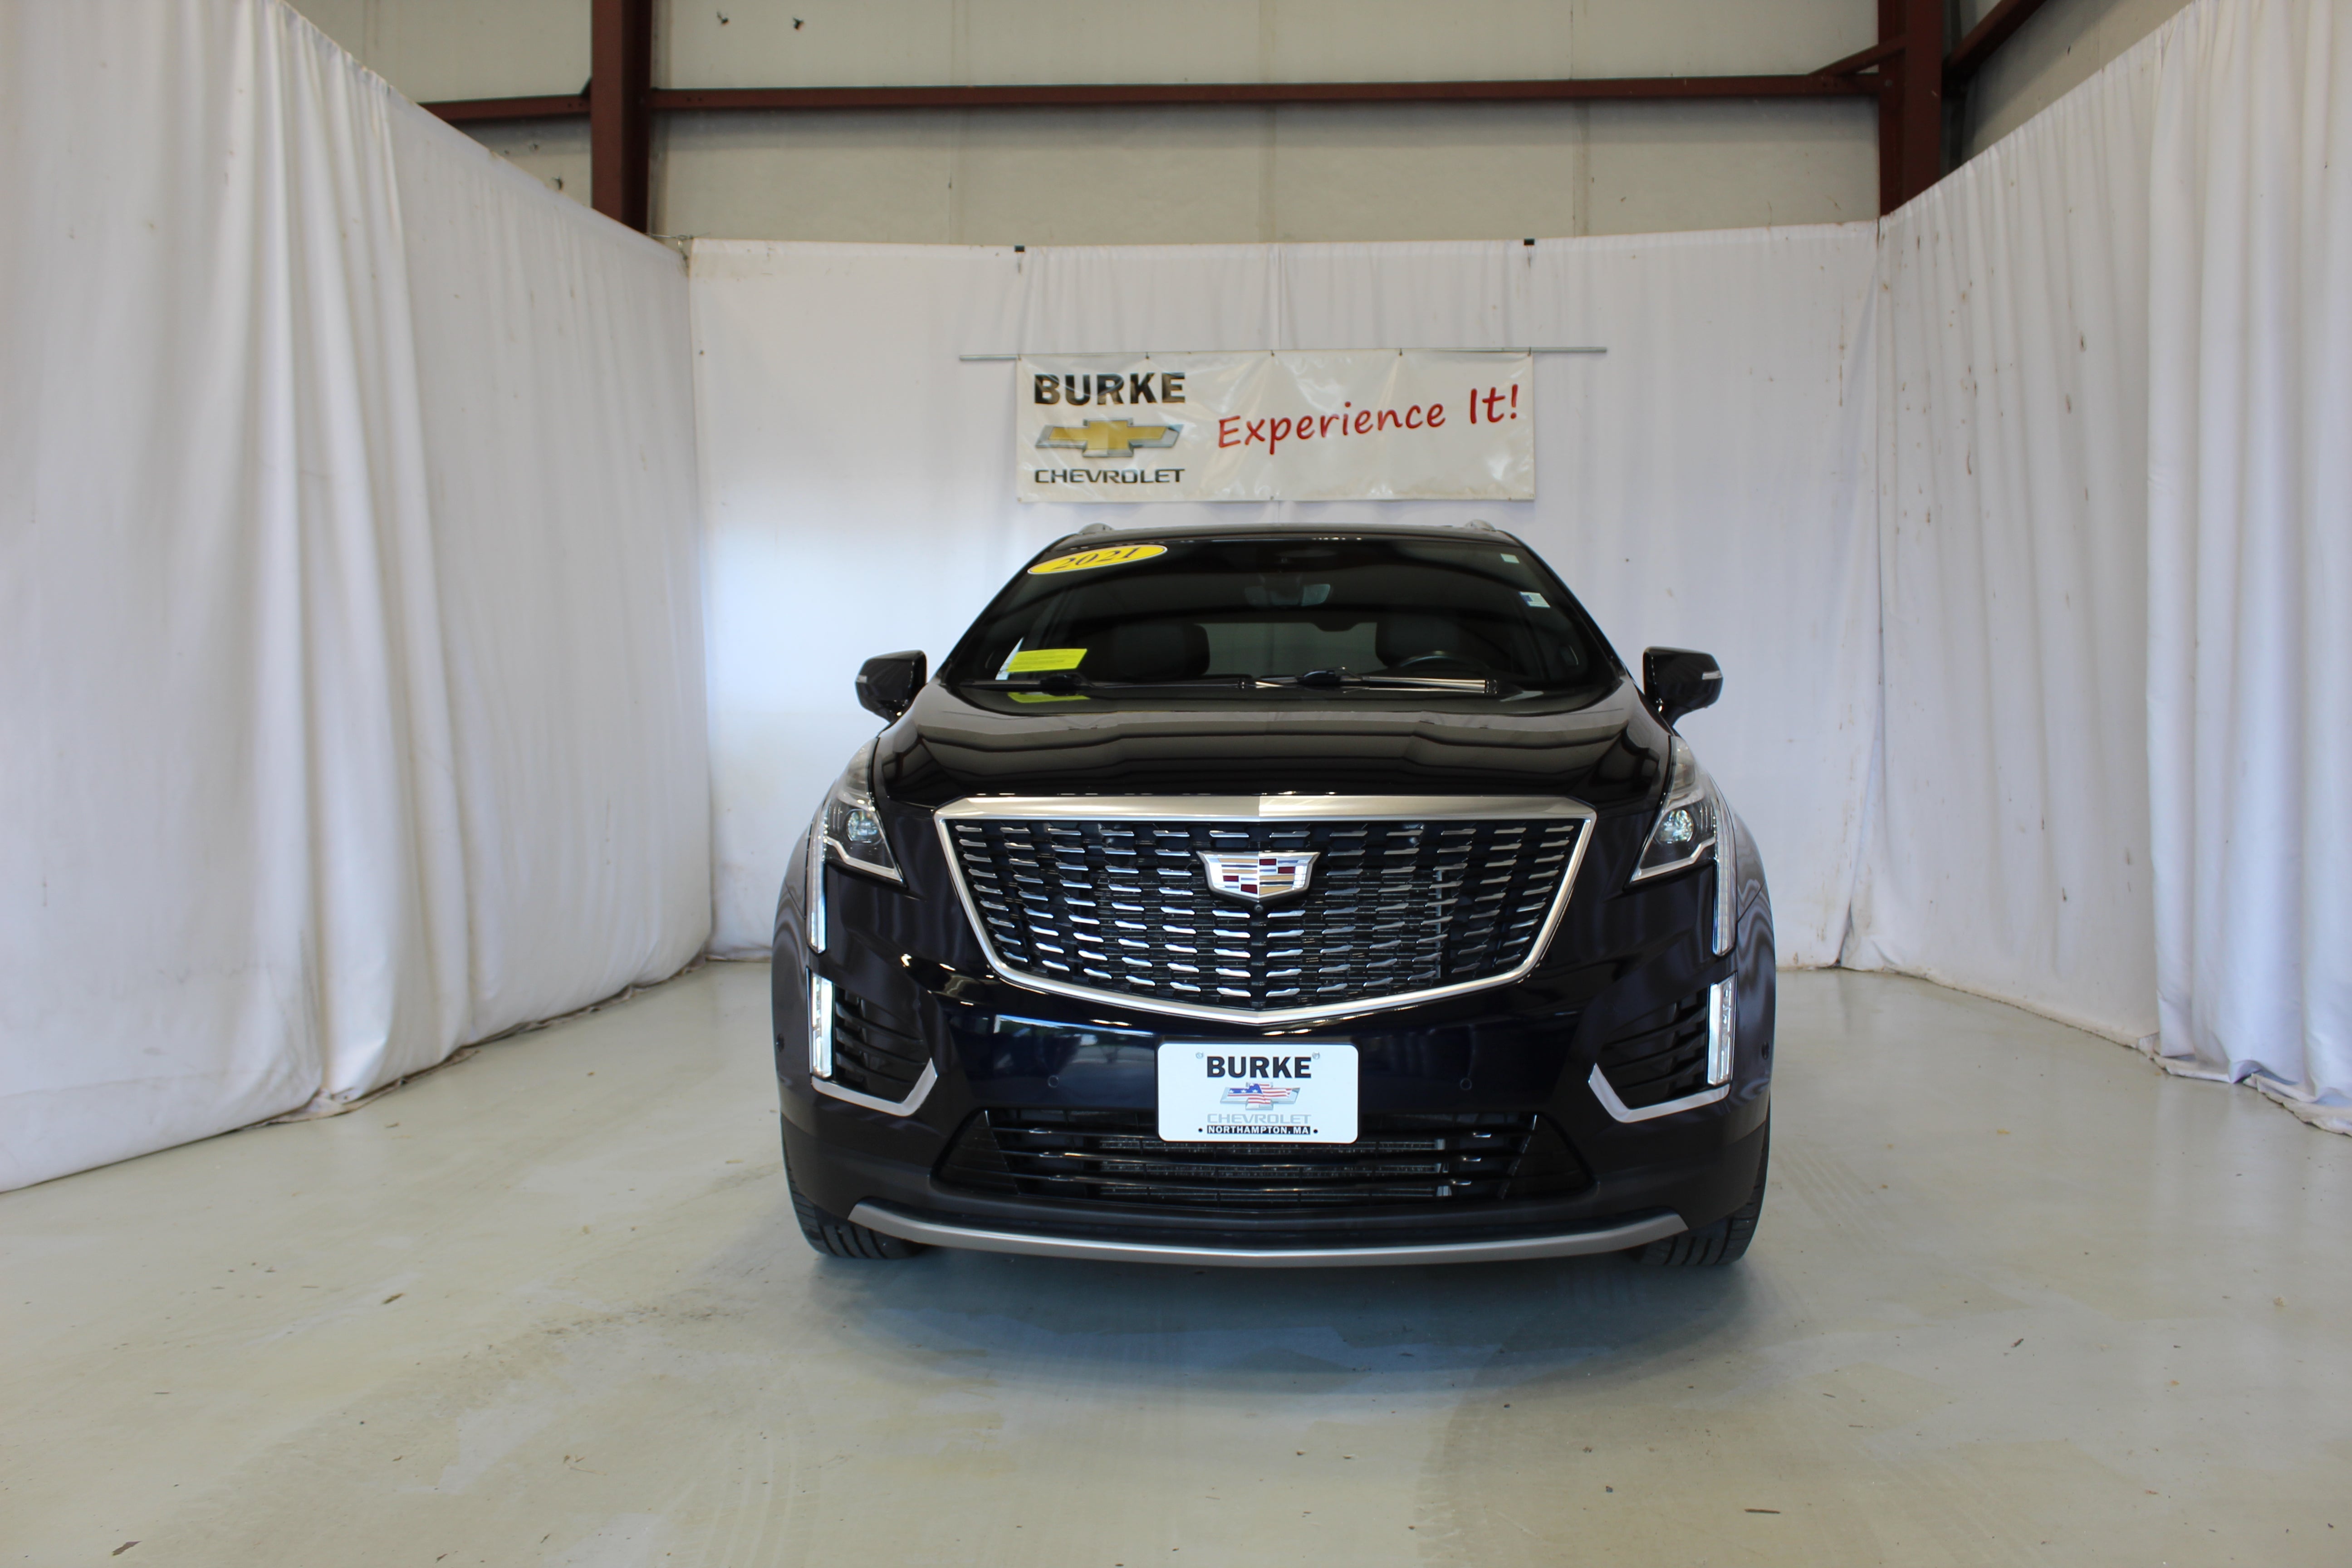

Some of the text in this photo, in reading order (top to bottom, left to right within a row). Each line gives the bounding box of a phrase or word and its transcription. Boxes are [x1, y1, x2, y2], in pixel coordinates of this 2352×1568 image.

[1034, 372, 1186, 405] BURKE
[1218, 384, 1519, 455] Experience It!
[1035, 469, 1185, 483] CHEVROLET
[1051, 547, 1141, 570] 2021
[1207, 1056, 1311, 1078] BURKE
[1207, 1114, 1311, 1124] CHEVROLET
